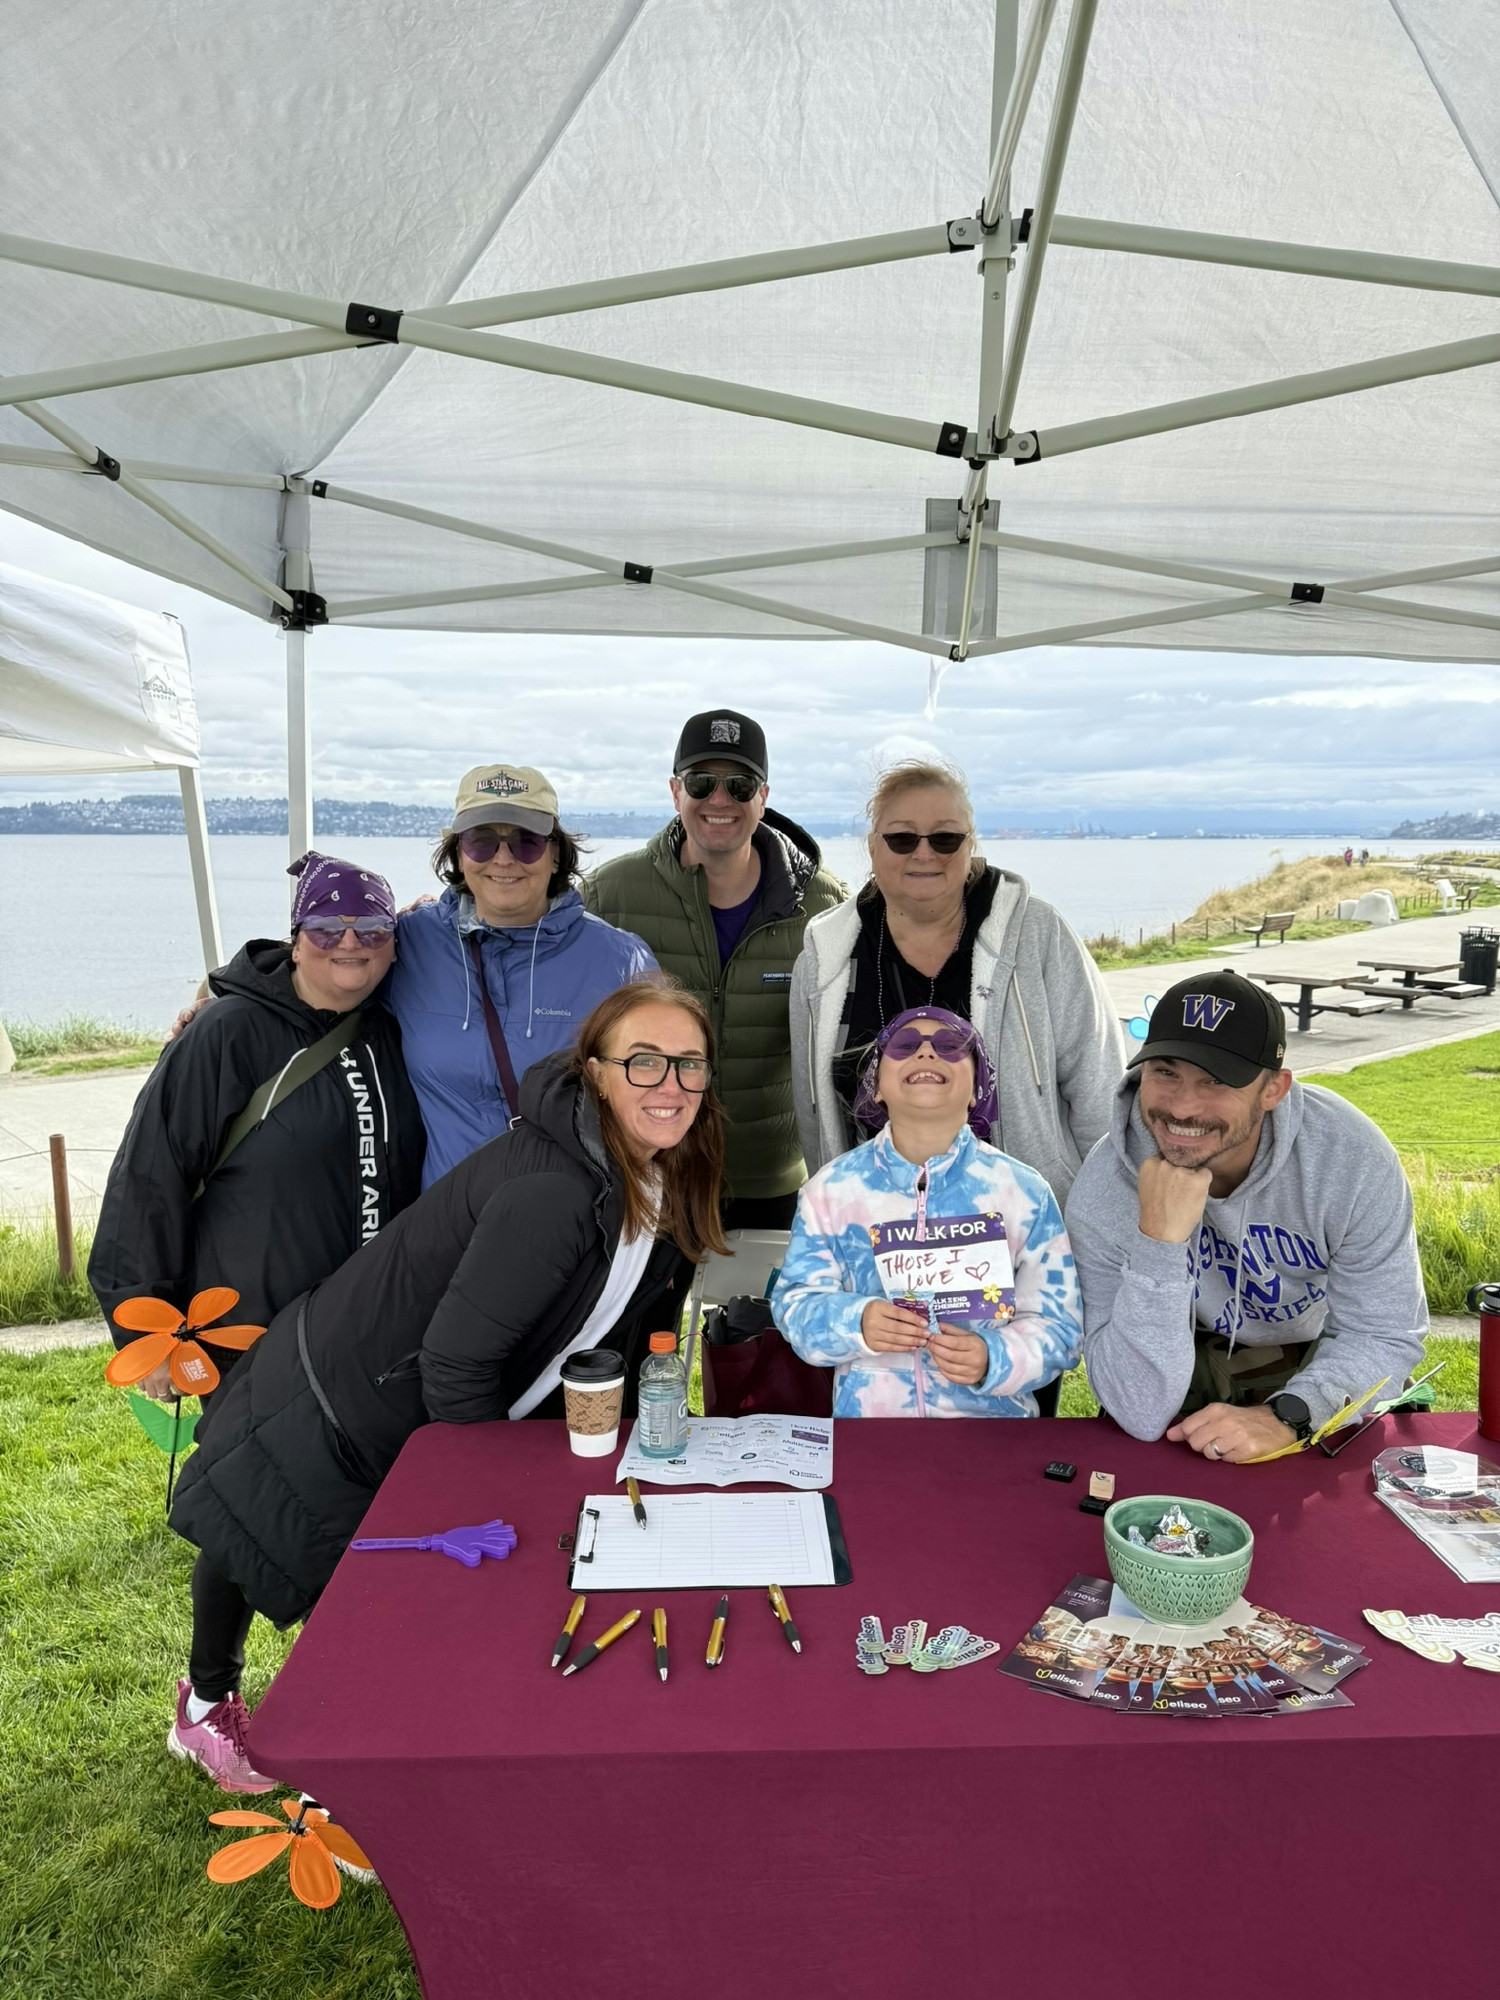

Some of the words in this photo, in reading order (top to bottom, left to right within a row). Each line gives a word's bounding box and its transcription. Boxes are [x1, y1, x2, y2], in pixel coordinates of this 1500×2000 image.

[508, 779, 529, 792] GAME
[541, 1008, 571, 1016] Columbia
[1182, 994, 1235, 1032] W
[346, 1072, 378, 1178] UNDER
[887, 1229, 892, 1242] I
[895, 1224, 947, 1242] WLK
[950, 1221, 987, 1239] FOR
[882, 1252, 937, 1278] THOSE
[946, 1249, 966, 1265] I
[907, 1269, 955, 1292] LOVE
[1218, 1264, 1281, 1305] W
[1215, 1282, 1326, 1334] HUSKIES
[863, 1618, 877, 1643] eliseo
[1407, 1614, 1494, 1628] eliseo
[890, 1627, 906, 1654] eliseo
[931, 1629, 953, 1656] eliseo
[953, 1642, 994, 1662] eliseo
[1050, 1672, 1084, 1687] eliseo
[1169, 1700, 1207, 1709] eliseo
[1301, 1693, 1335, 1703] eliseo
